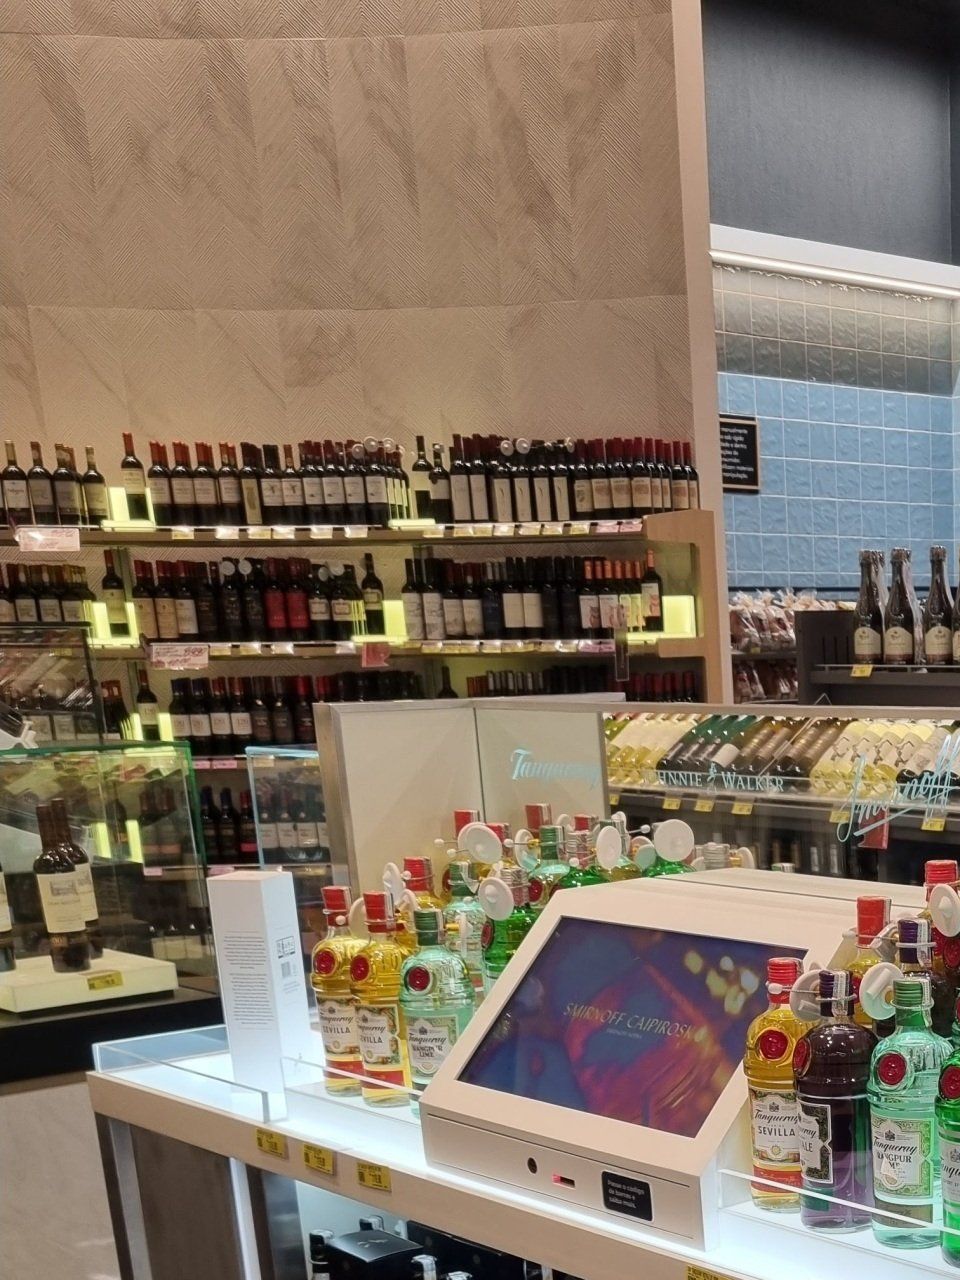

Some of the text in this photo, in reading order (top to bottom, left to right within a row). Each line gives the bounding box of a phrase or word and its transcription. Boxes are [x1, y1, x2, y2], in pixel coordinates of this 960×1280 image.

[721, 770, 784, 792] WALKER
[563, 1002, 627, 1026] SMIRNOFF
[322, 1025, 351, 1035] SEVILLA
[360, 1034, 383, 1044] EVILLA
[408, 1032, 448, 1045] Tanqueray
[754, 1108, 801, 1125] Tanqueray
[757, 1125, 796, 1138] SEVILLA
[873, 1136, 918, 1155] Tanqueray
